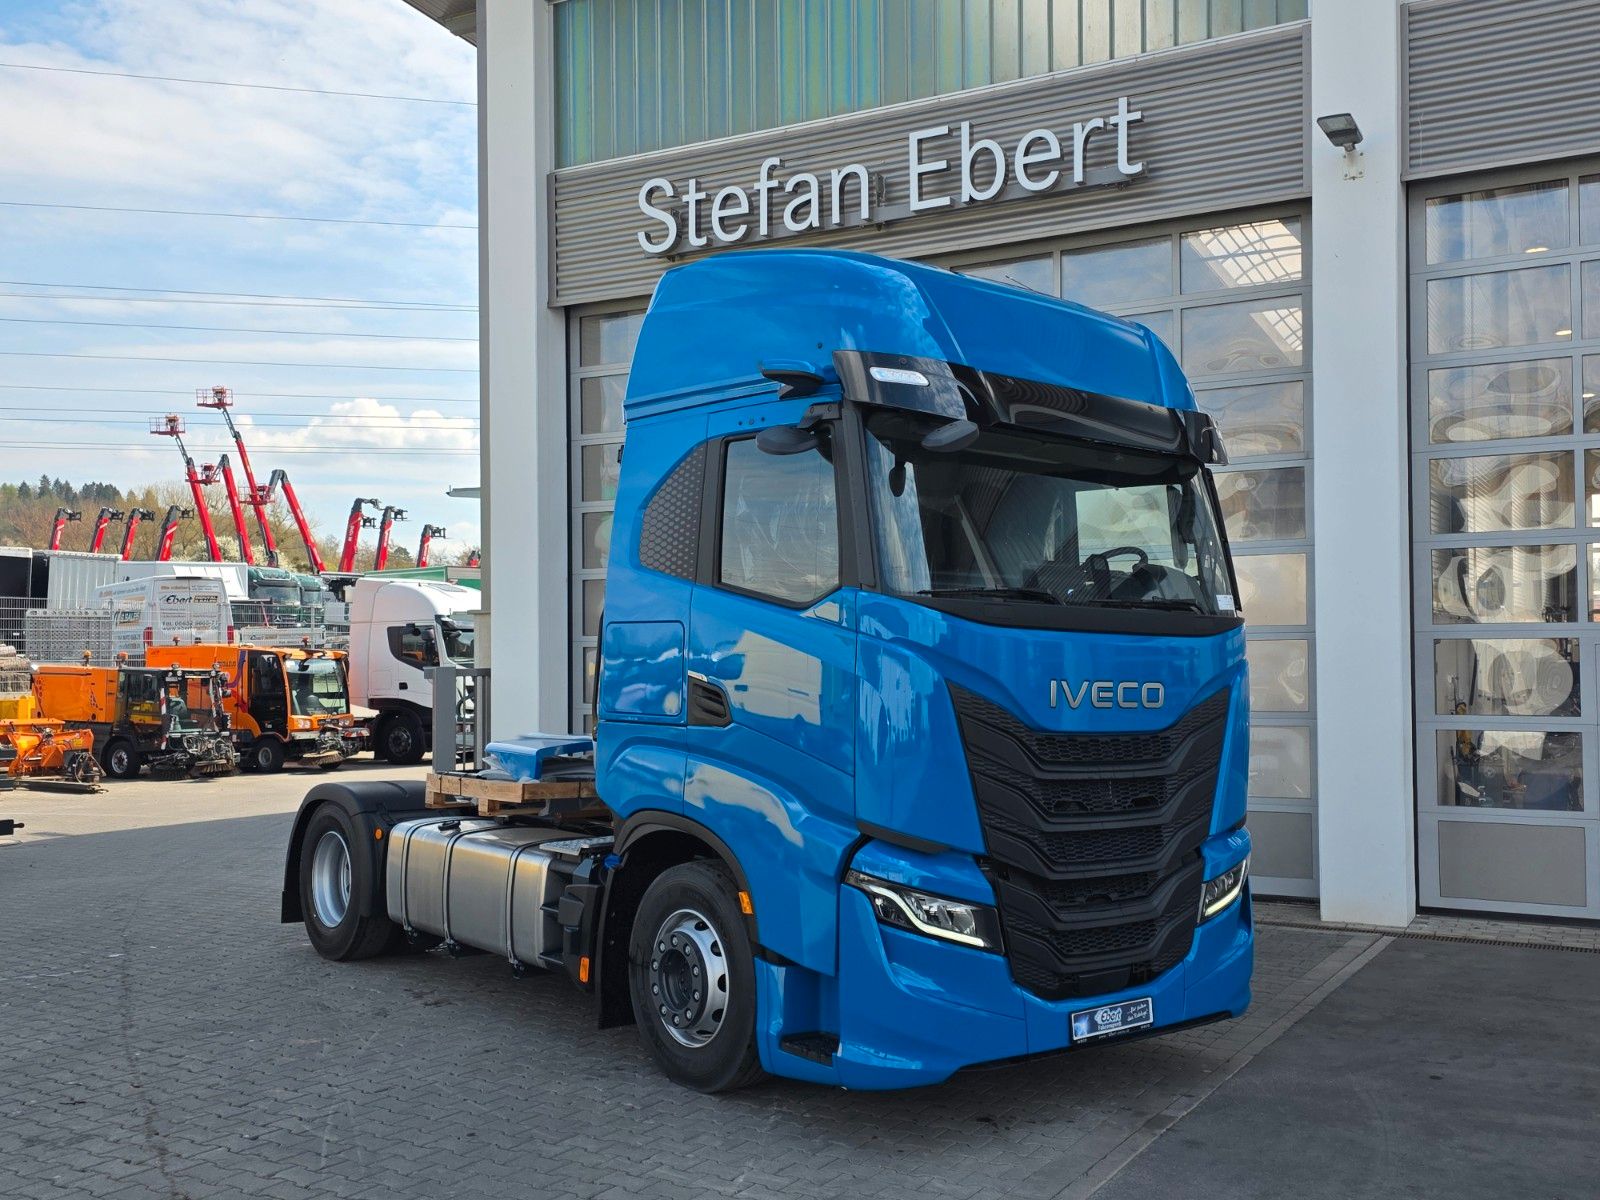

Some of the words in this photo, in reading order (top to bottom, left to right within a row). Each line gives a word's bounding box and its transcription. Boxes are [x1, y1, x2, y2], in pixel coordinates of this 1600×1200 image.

[637, 157, 872, 255] Stefan
[908, 96, 1144, 212] Ebert
[1050, 680, 1165, 709] IVECO
